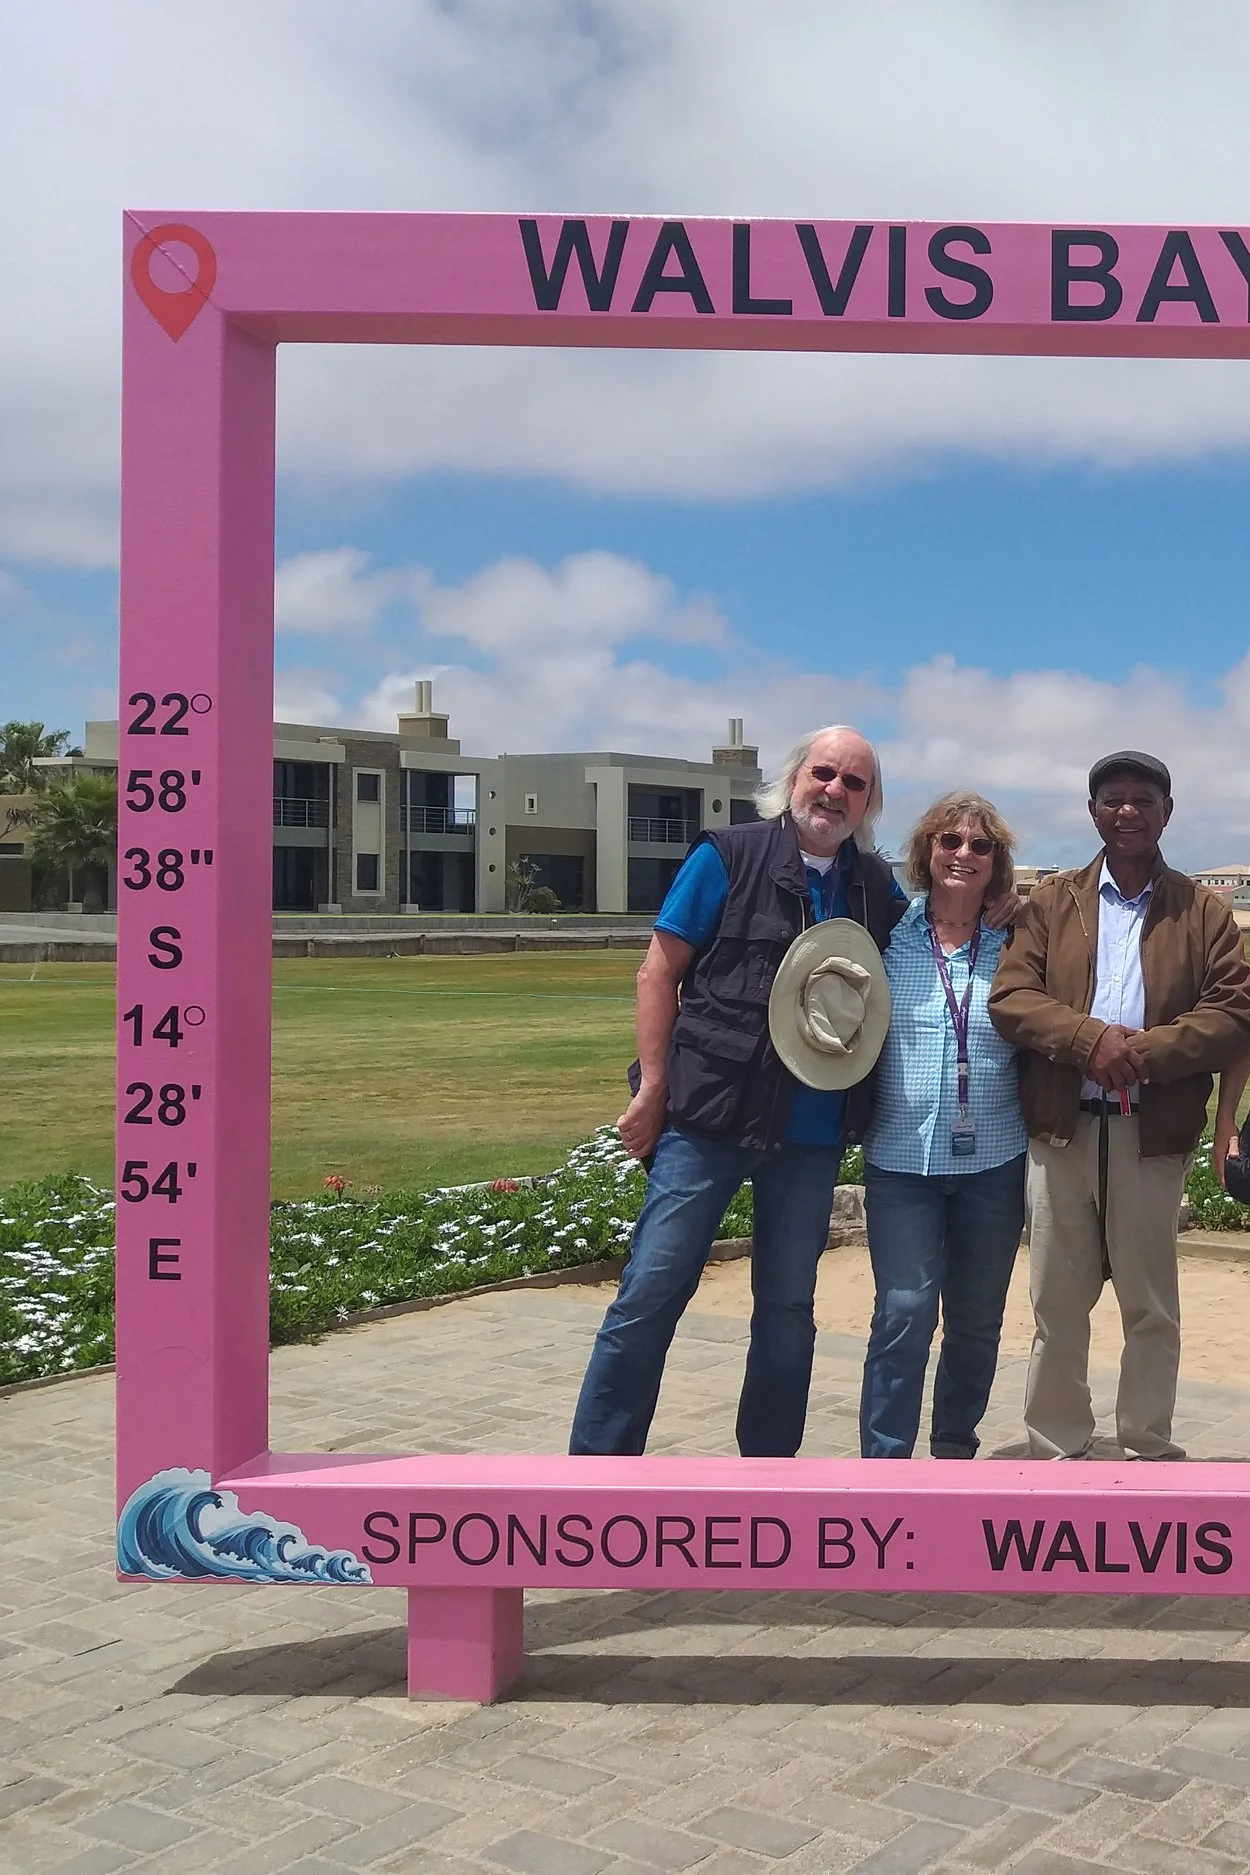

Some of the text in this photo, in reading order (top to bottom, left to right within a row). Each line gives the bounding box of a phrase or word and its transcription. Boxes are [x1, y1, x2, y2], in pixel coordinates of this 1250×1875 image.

[517, 219, 994, 321] WALVIS
[125, 769, 201, 813] 58'
[147, 925, 183, 970] S
[123, 1081, 202, 1127] 28'
[120, 1160, 197, 1204] 54'
[148, 1237, 182, 1281] E
[361, 1511, 792, 1569] SPONSORED
[818, 1517, 916, 1570] BY:
[981, 1519, 1233, 1575] WALVIS
